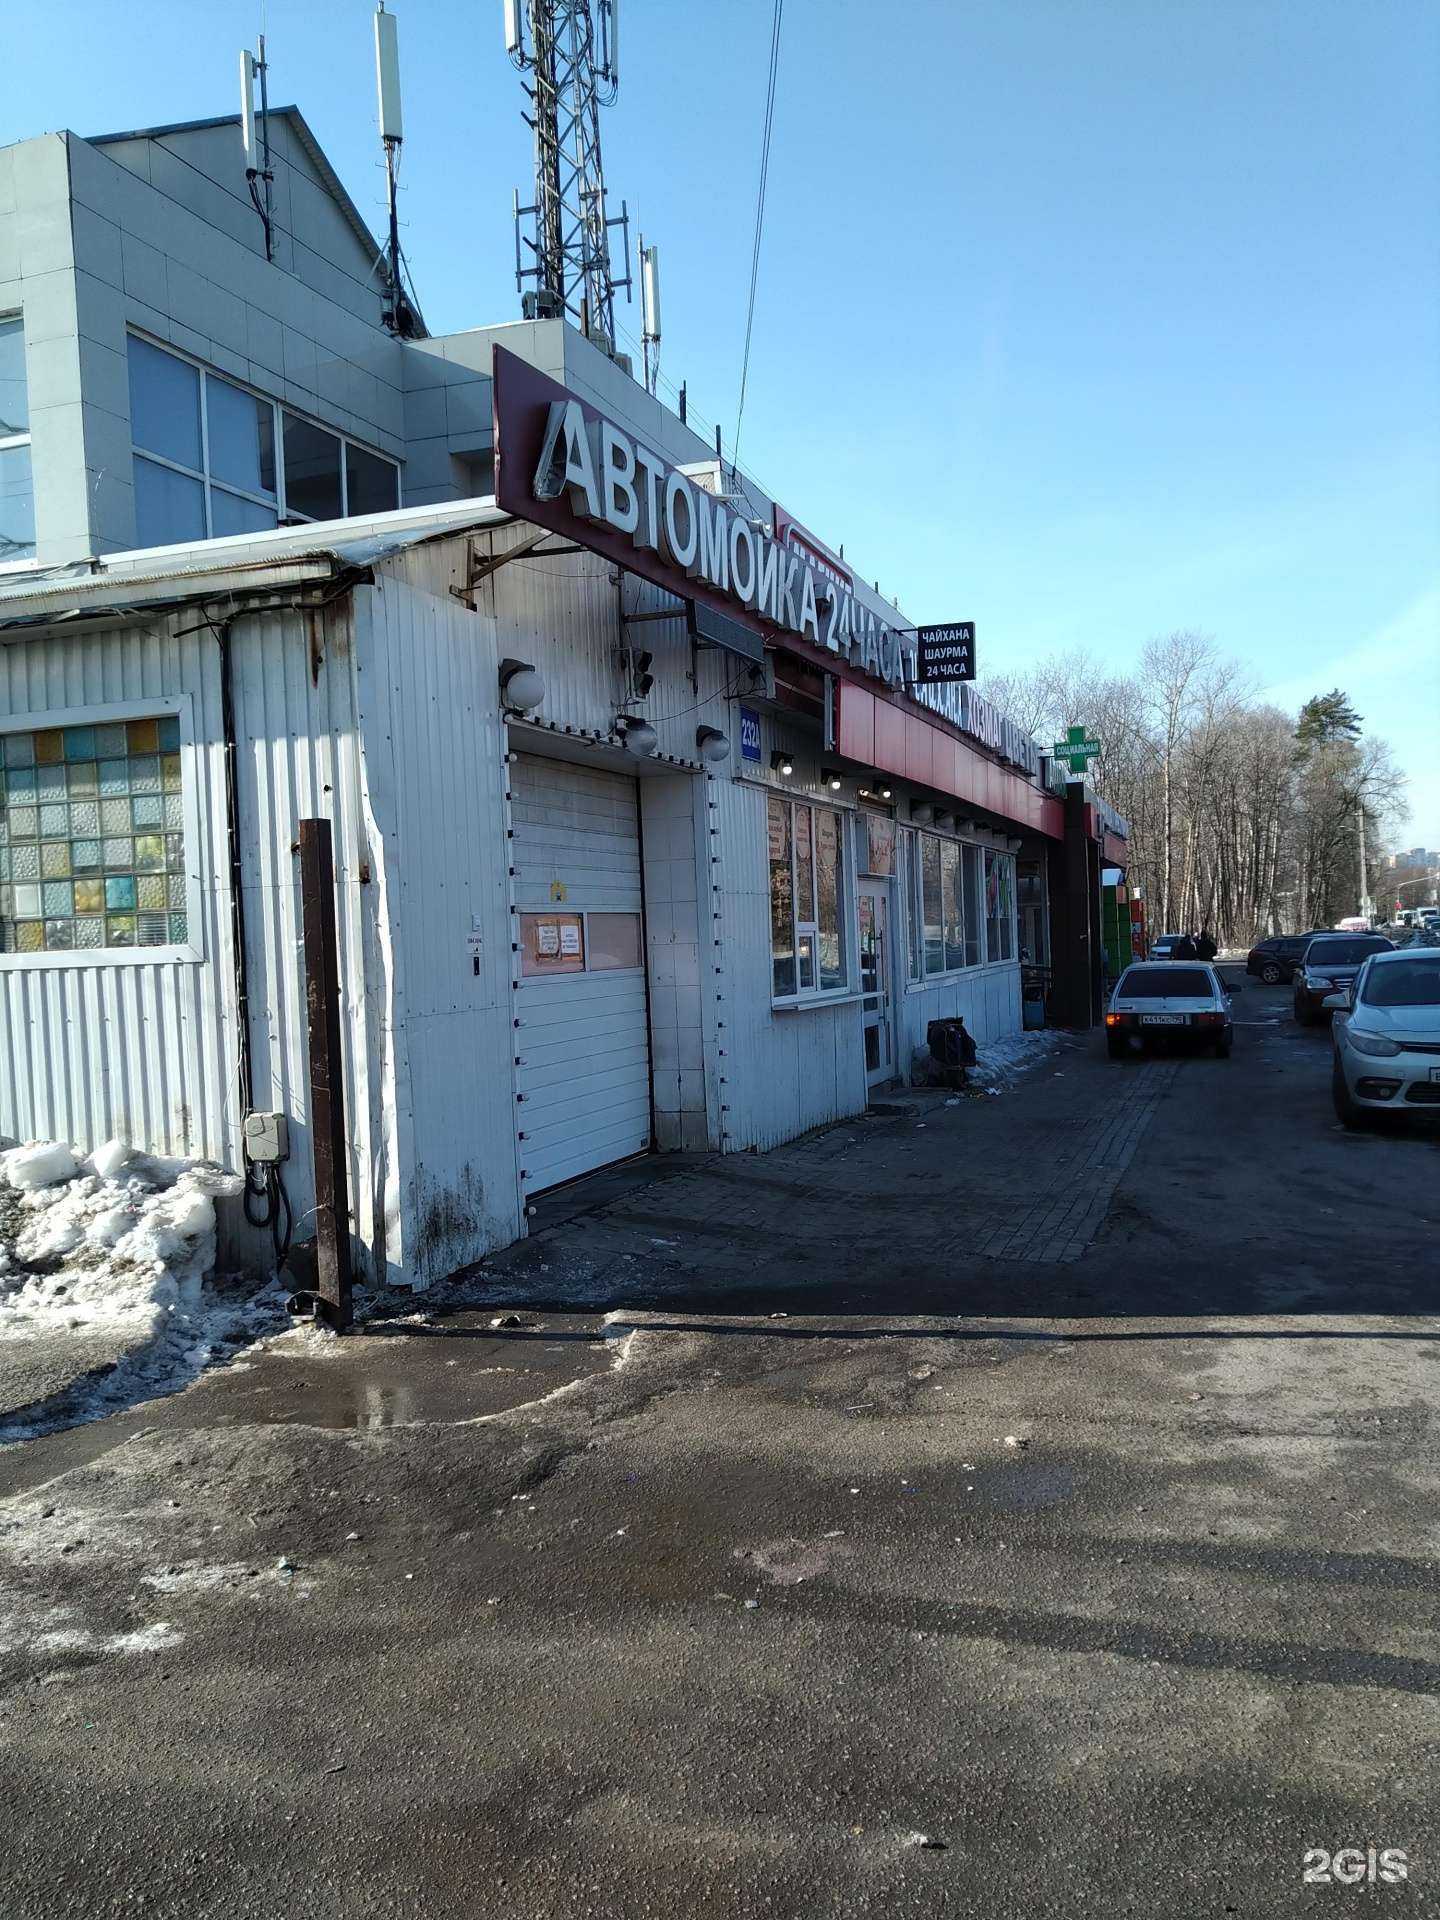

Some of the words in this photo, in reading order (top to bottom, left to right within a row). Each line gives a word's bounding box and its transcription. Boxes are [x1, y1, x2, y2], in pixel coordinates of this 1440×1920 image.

[534, 399, 819, 642] АВТОМОЙКА
[922, 628, 970, 642] ЧАЙХАНА
[924, 646, 968, 660] ШАУРМА
[926, 666, 938, 677] 24
[940, 663, 967, 675] ЧАСА
[742, 718, 761, 750] 232А
